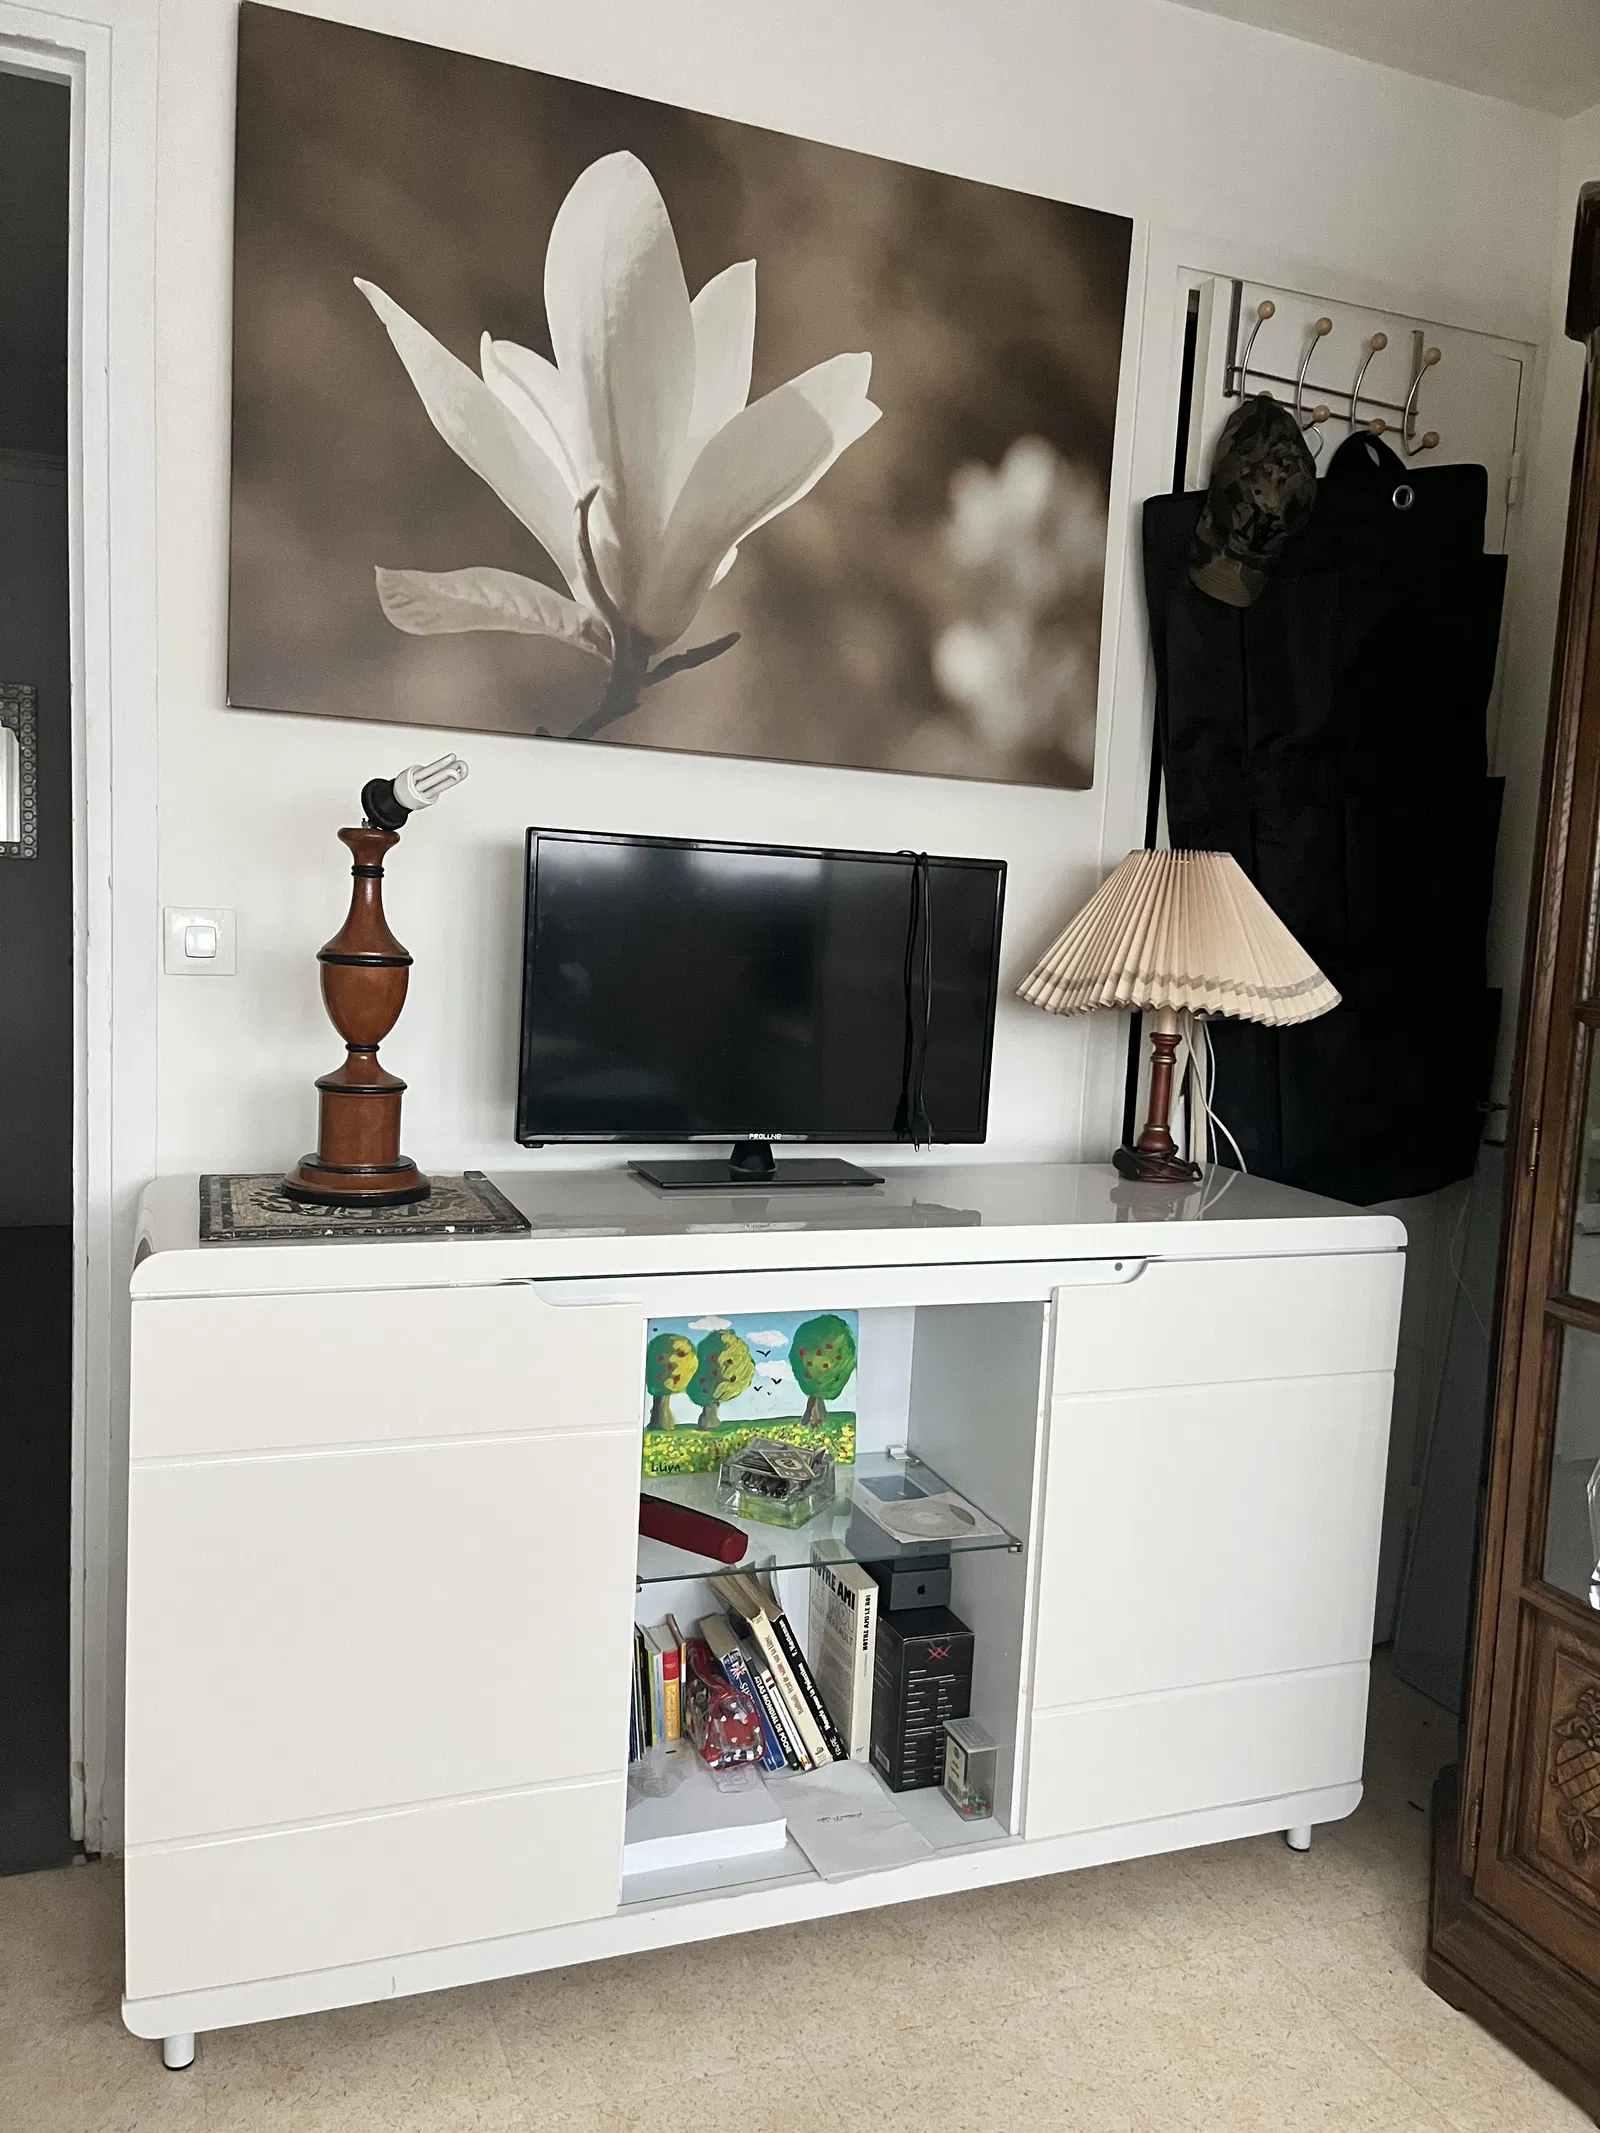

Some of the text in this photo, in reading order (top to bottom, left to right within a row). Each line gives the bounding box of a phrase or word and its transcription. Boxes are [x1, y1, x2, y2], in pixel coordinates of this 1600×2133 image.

[812, 1550, 837, 1593] NOTRE
[837, 1580, 856, 1611] AMI
[864, 1607, 871, 1615] LE
[754, 1676, 792, 1753] ATLAS MONDIAL DE POCHE
[799, 1663, 830, 1730] Mourir pour la Palestine
